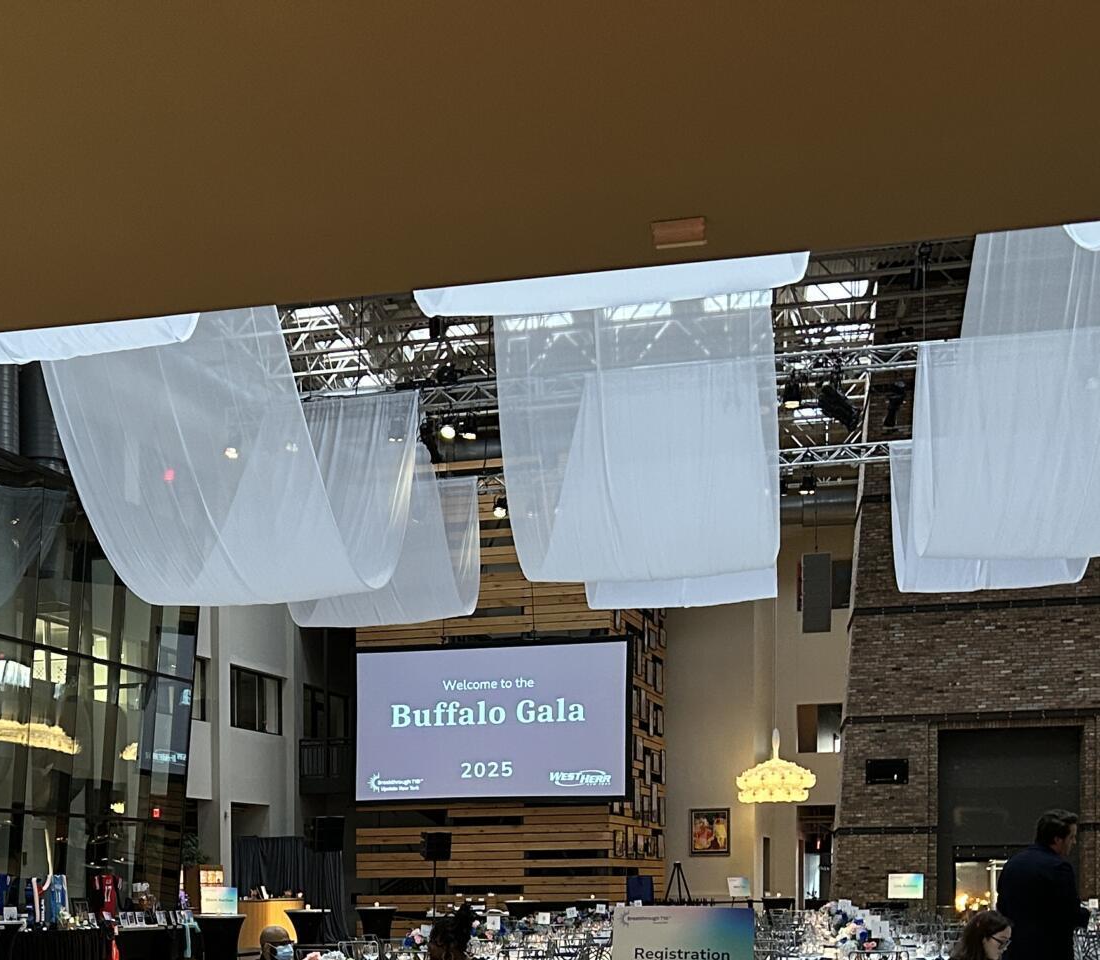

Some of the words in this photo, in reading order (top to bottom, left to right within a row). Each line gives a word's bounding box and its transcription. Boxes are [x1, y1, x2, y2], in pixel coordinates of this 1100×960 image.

[442, 679, 498, 691] Welcome
[500, 679, 512, 689] to
[514, 677, 535, 688] the
[391, 701, 506, 728] Buffalo
[516, 698, 585, 723] Gala
[460, 761, 513, 779] 2025
